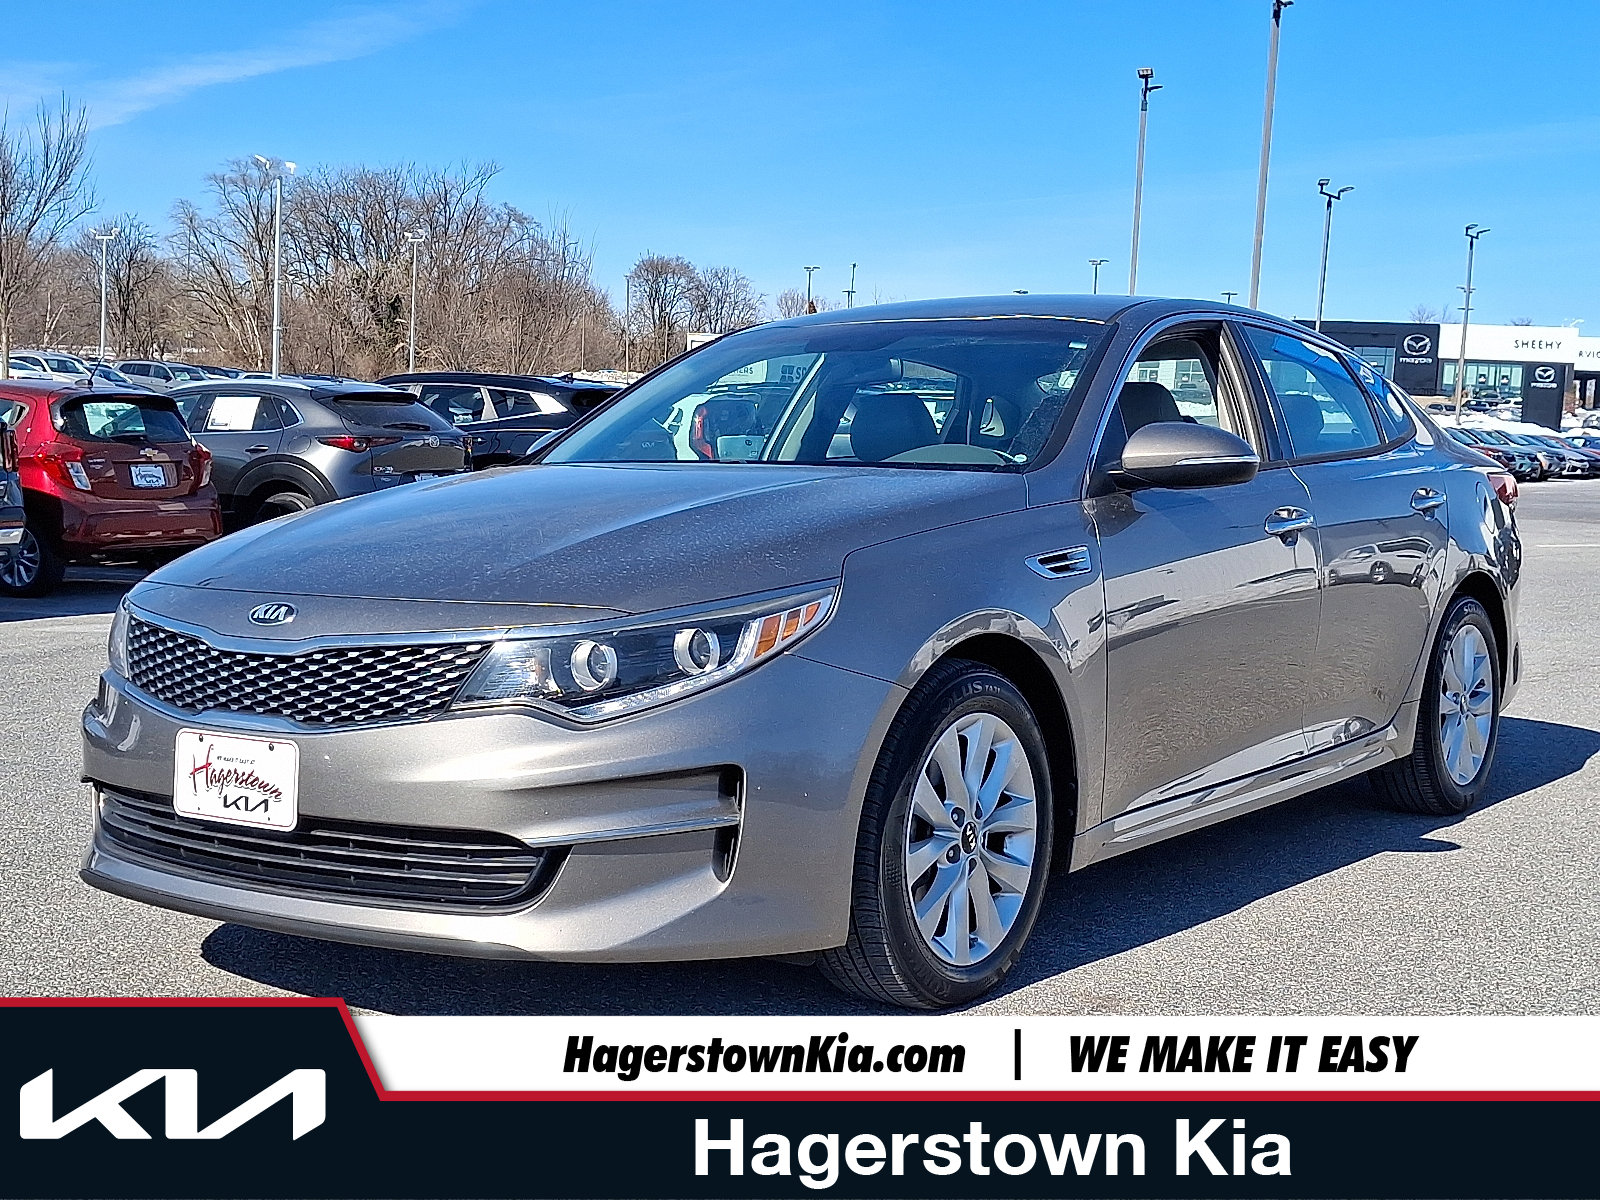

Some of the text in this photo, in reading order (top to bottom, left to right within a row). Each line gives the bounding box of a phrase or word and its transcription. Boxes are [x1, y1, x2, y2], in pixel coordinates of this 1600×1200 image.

[1514, 339, 1562, 349] SHEEHY
[1399, 357, 1433, 365] mazda
[252, 604, 289, 621] KIA
[189, 743, 283, 802] Hagerstown
[223, 794, 269, 813] KIA
